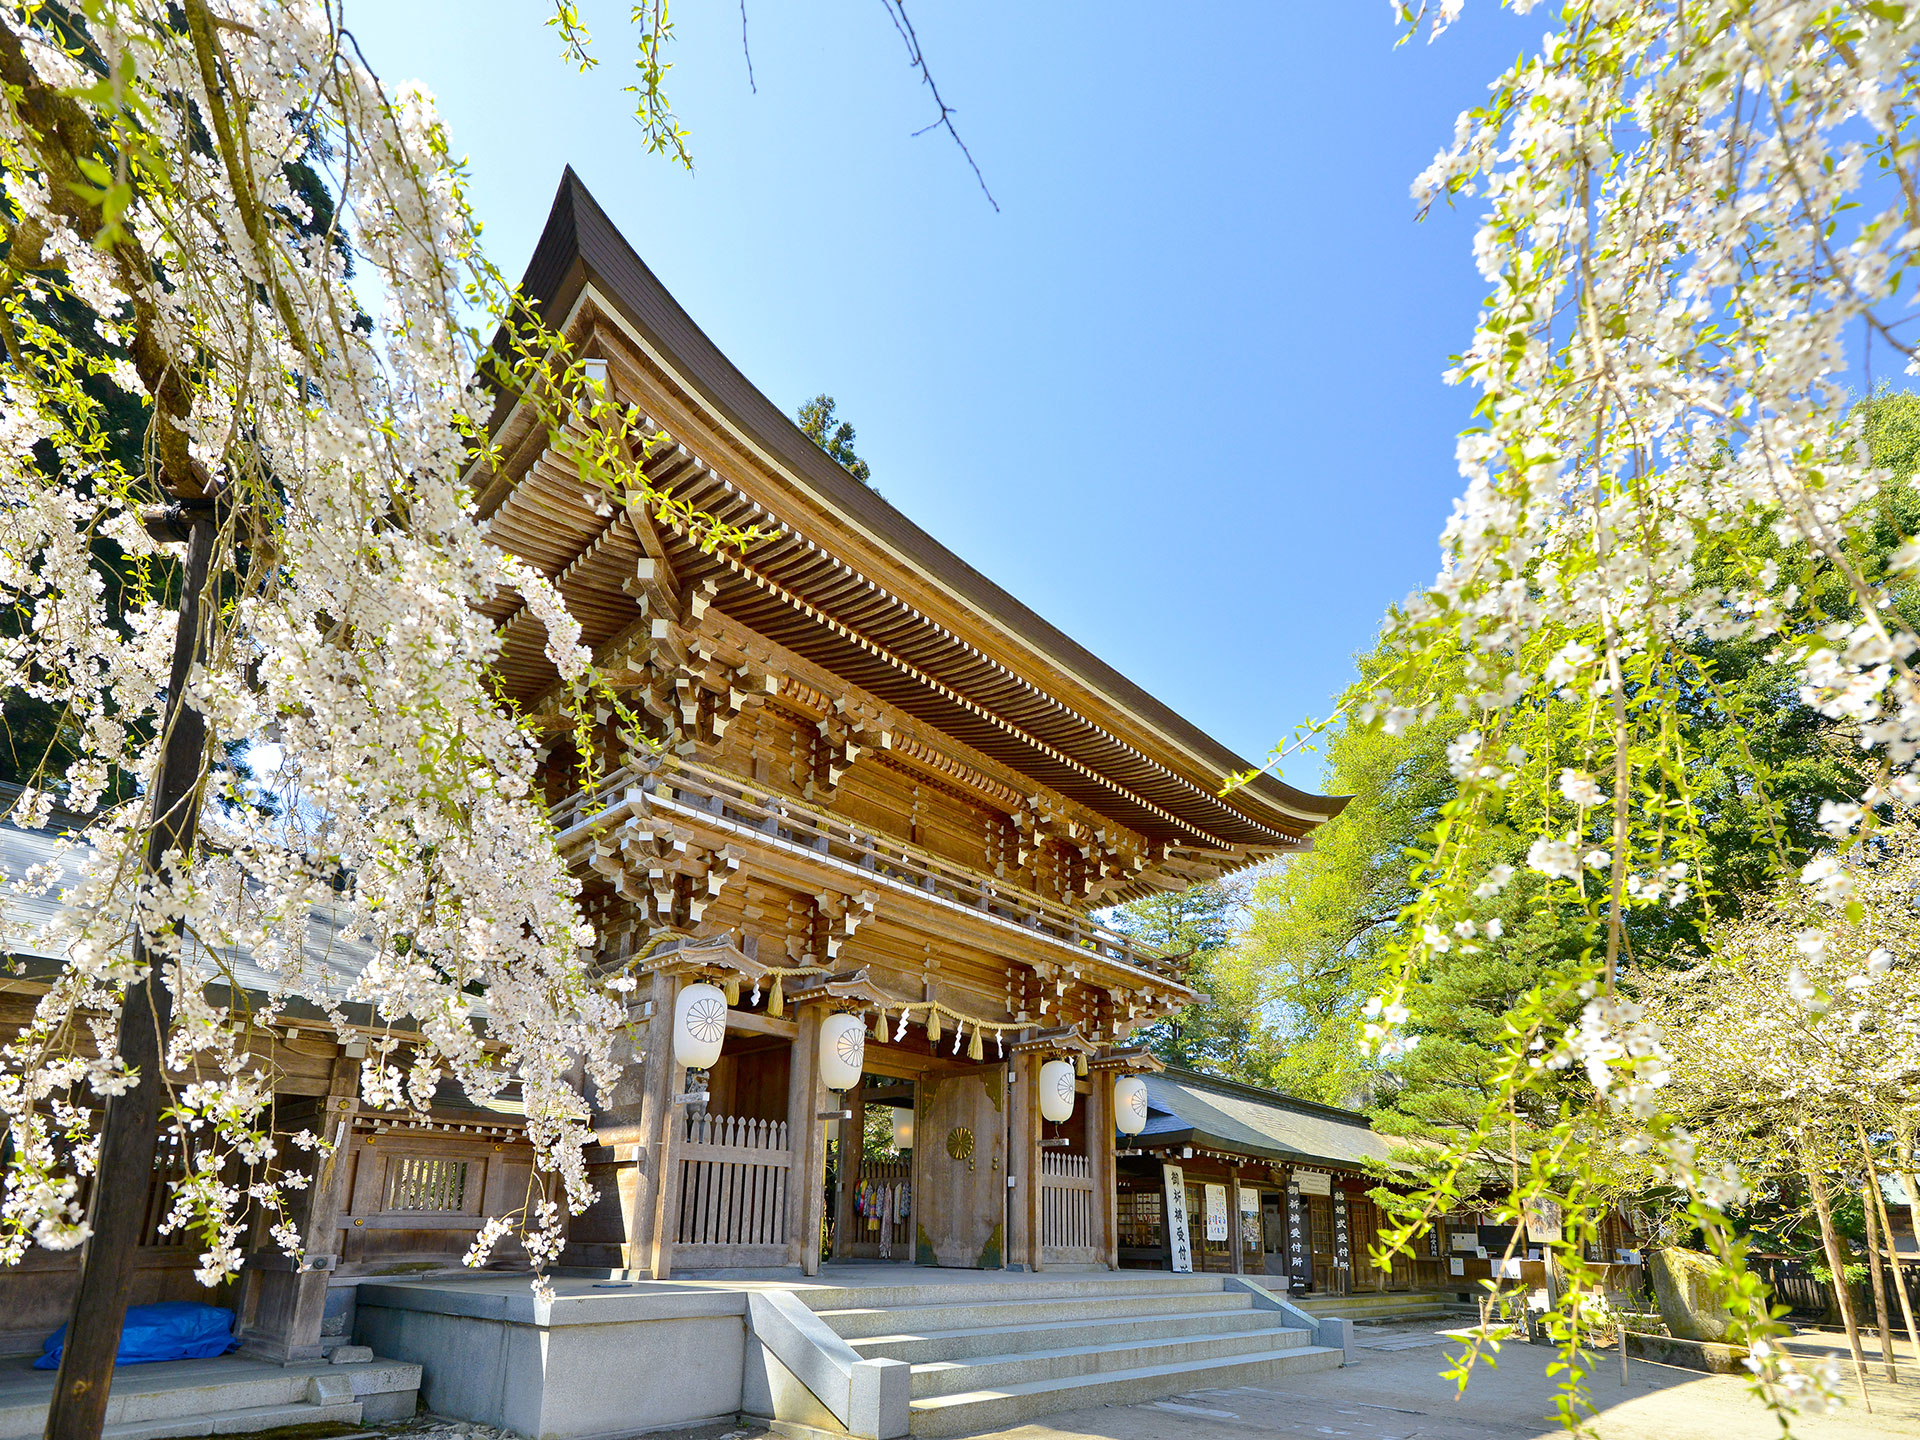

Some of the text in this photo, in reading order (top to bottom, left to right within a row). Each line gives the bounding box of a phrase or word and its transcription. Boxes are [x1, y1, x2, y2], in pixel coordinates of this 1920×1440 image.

[1334, 1192, 1349, 1271] 結婚式受付所
